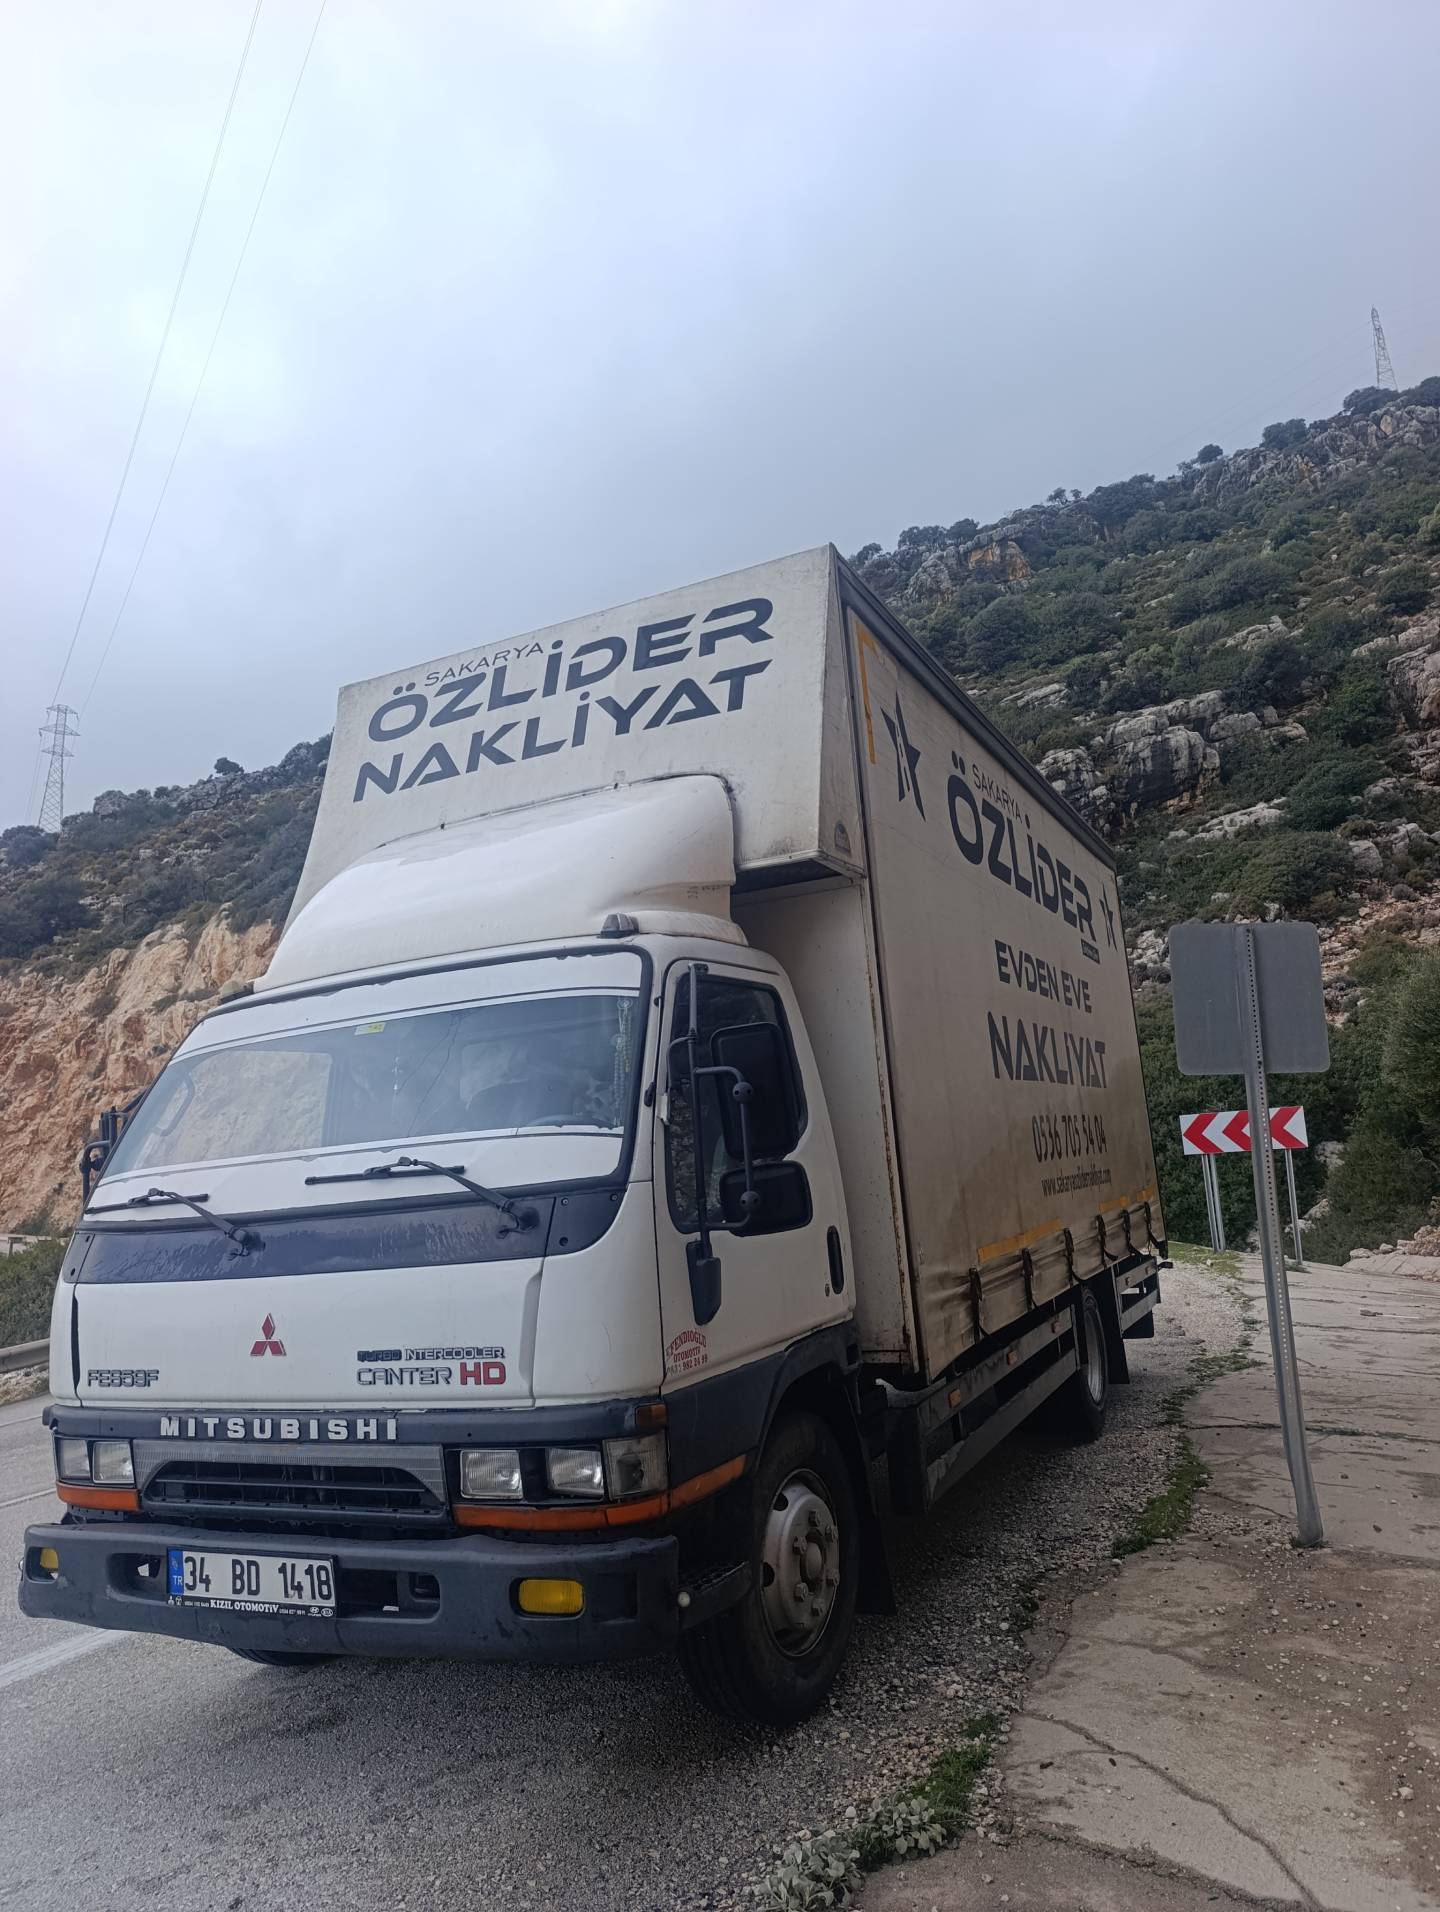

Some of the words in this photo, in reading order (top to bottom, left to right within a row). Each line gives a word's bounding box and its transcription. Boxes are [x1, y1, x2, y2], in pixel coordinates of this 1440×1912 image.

[368, 597, 774, 742] ÖZLİDER
[424, 641, 544, 687] SAKARYA
[352, 659, 773, 803] NAKLİYAT
[971, 763, 1023, 824] SAKARYA
[947, 750, 1097, 942] ÖZLİDER
[994, 939, 1060, 1002] EVDEN
[1061, 970, 1093, 1014] EVE
[357, 1367, 452, 1386] CANTER
[459, 1361, 507, 1386] HD
[405, 1347, 506, 1361] INTERCOOLER
[160, 1416, 398, 1441] MITSUBISHI
[172, 1575, 183, 1586] TR
[184, 1556, 212, 1593] 34
[231, 1558, 261, 1597] BD
[277, 1562, 333, 1601] 1418
[209, 1599, 234, 1611] KIZIL
